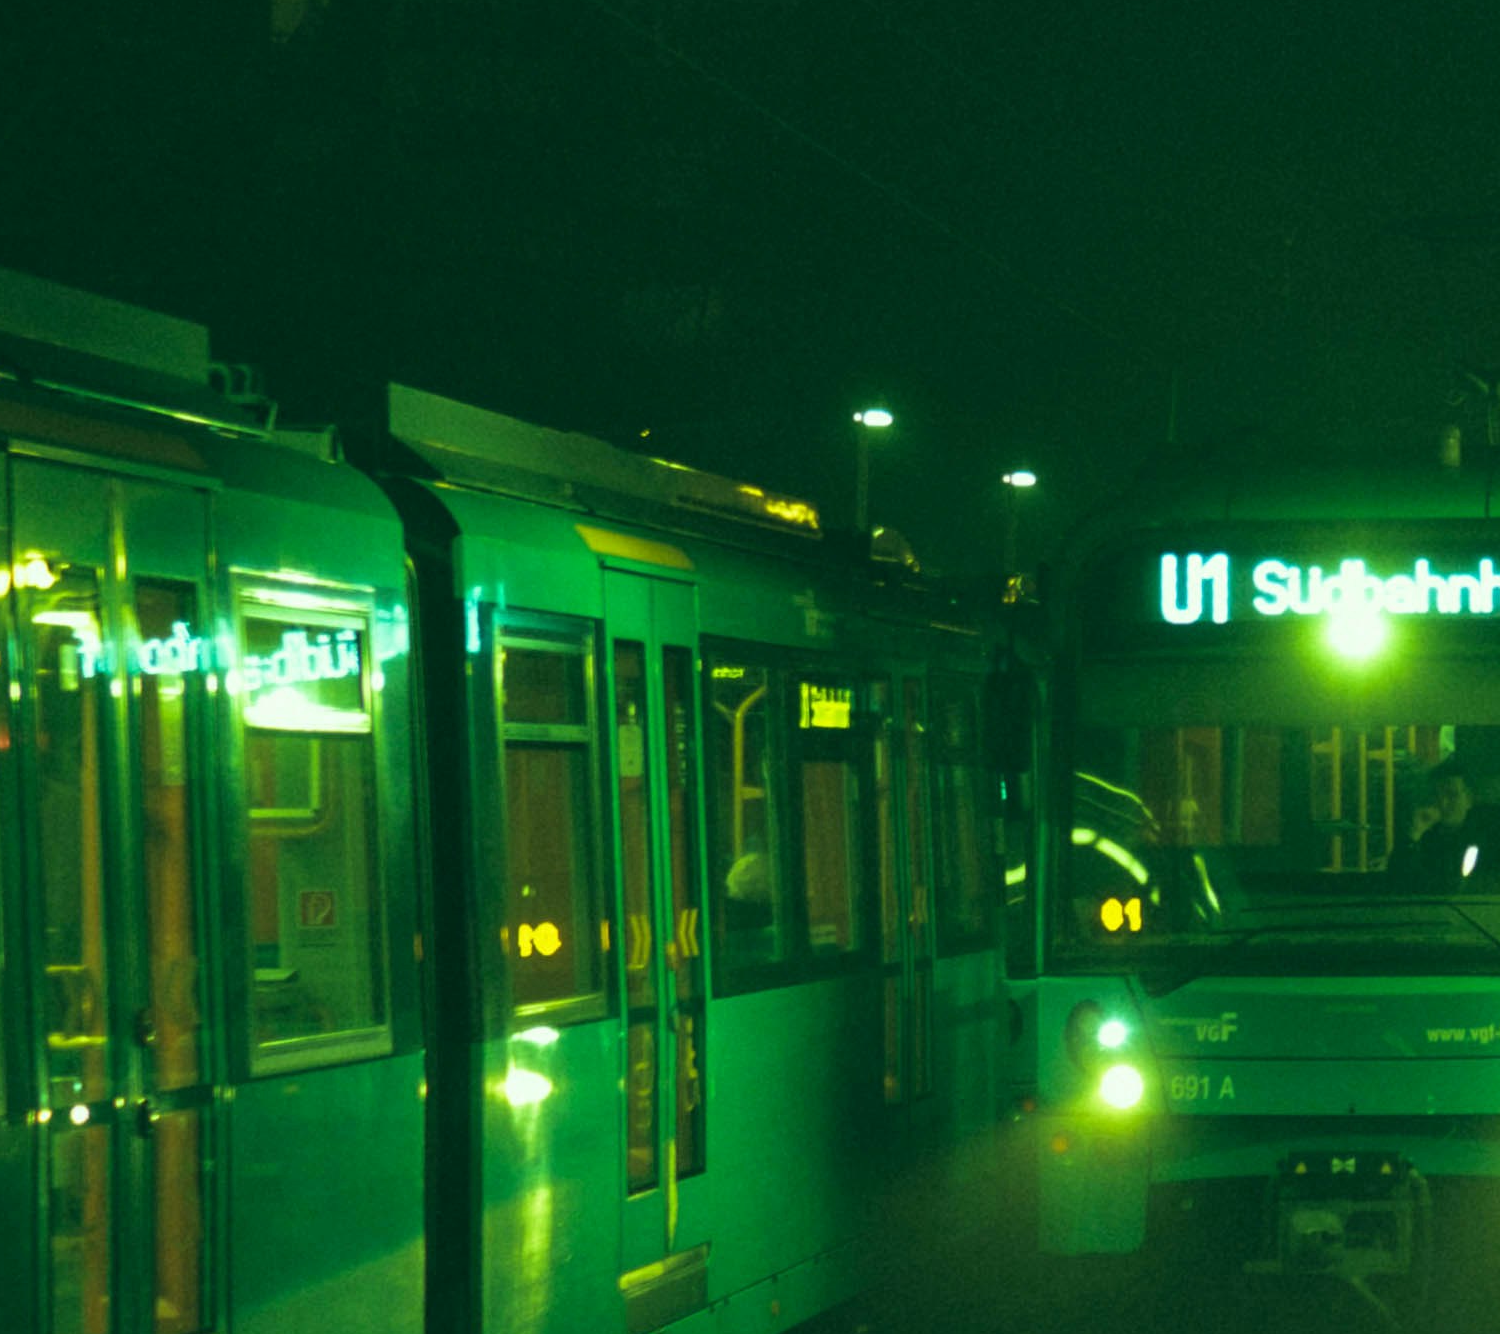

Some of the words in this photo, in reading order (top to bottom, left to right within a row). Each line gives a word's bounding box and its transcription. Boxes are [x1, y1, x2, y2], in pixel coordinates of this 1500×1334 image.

[1160, 553, 1231, 624] U1
[1170, 1074, 1211, 1100] 691
[1218, 1074, 1237, 1100] A
